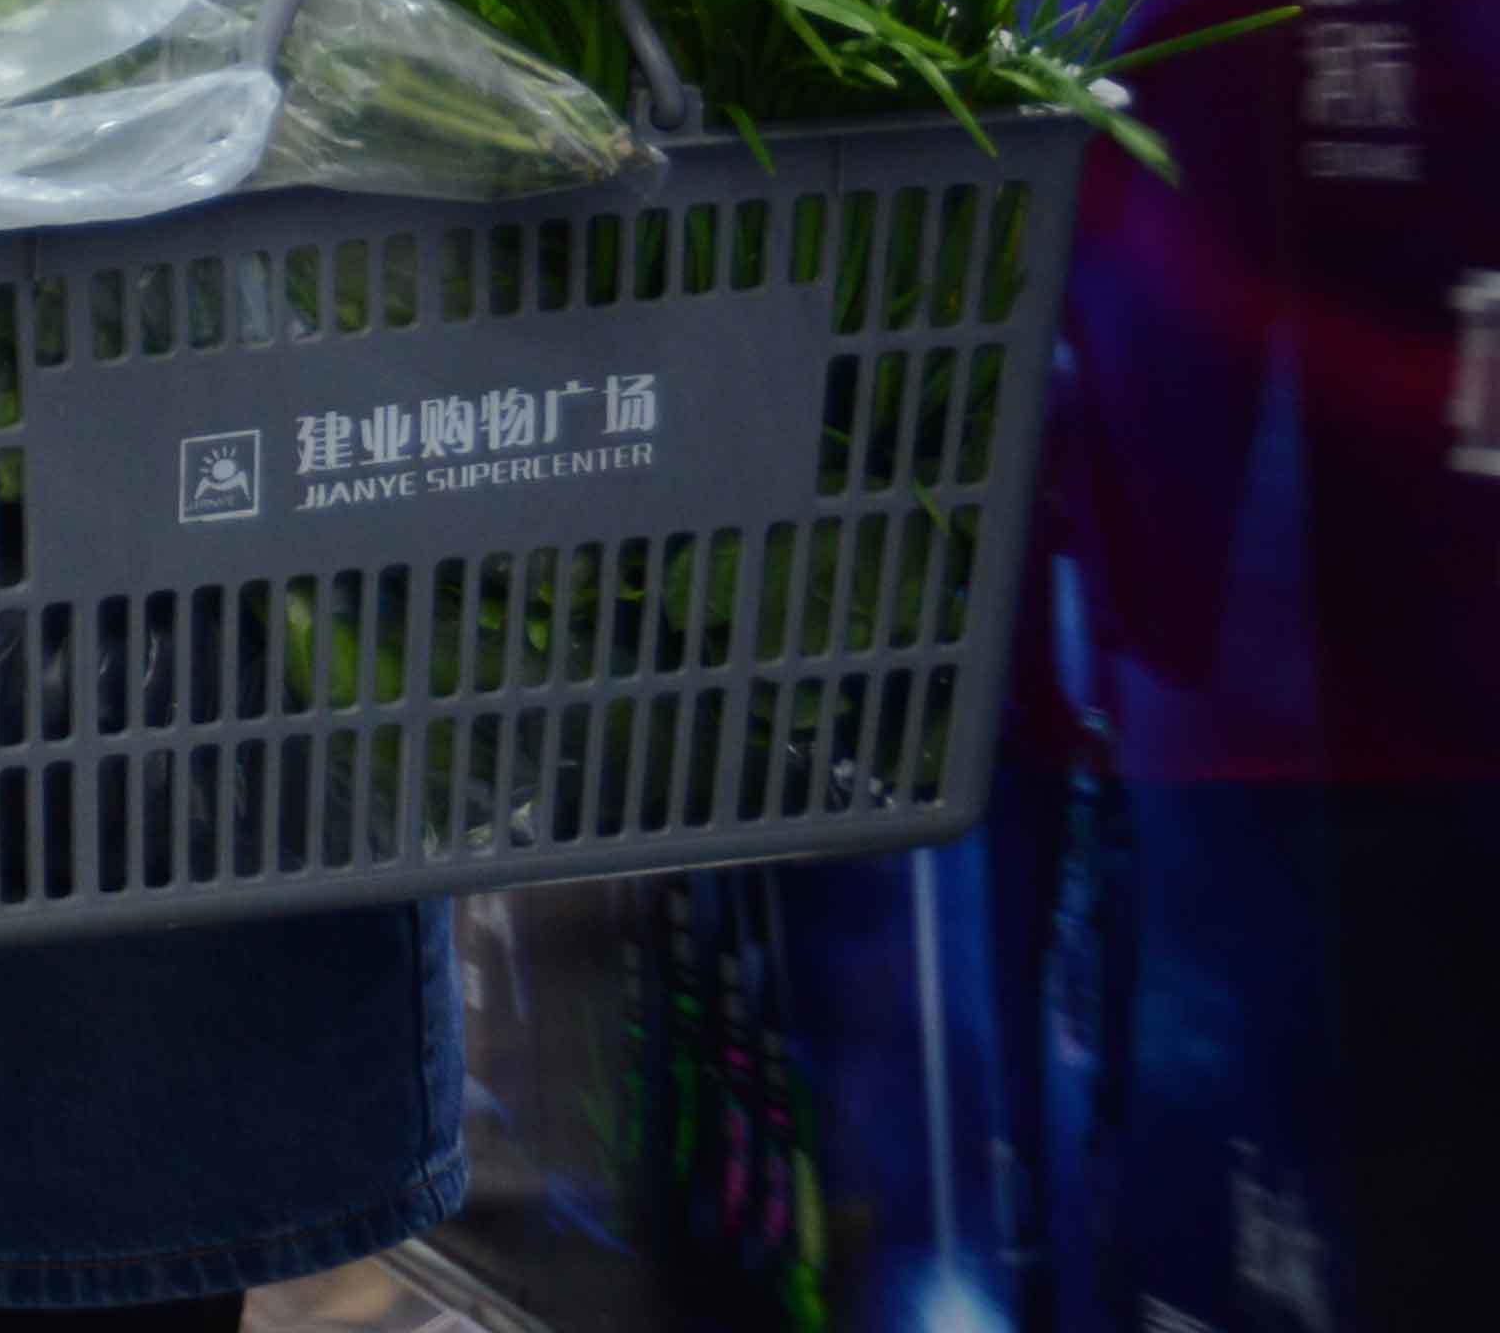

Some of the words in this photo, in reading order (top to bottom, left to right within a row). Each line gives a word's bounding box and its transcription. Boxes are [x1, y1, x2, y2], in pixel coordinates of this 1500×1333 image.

[296, 374, 657, 475] 建业购物广场
[295, 472, 417, 512] JIANYE
[426, 443, 653, 492] SUPERCENTER
